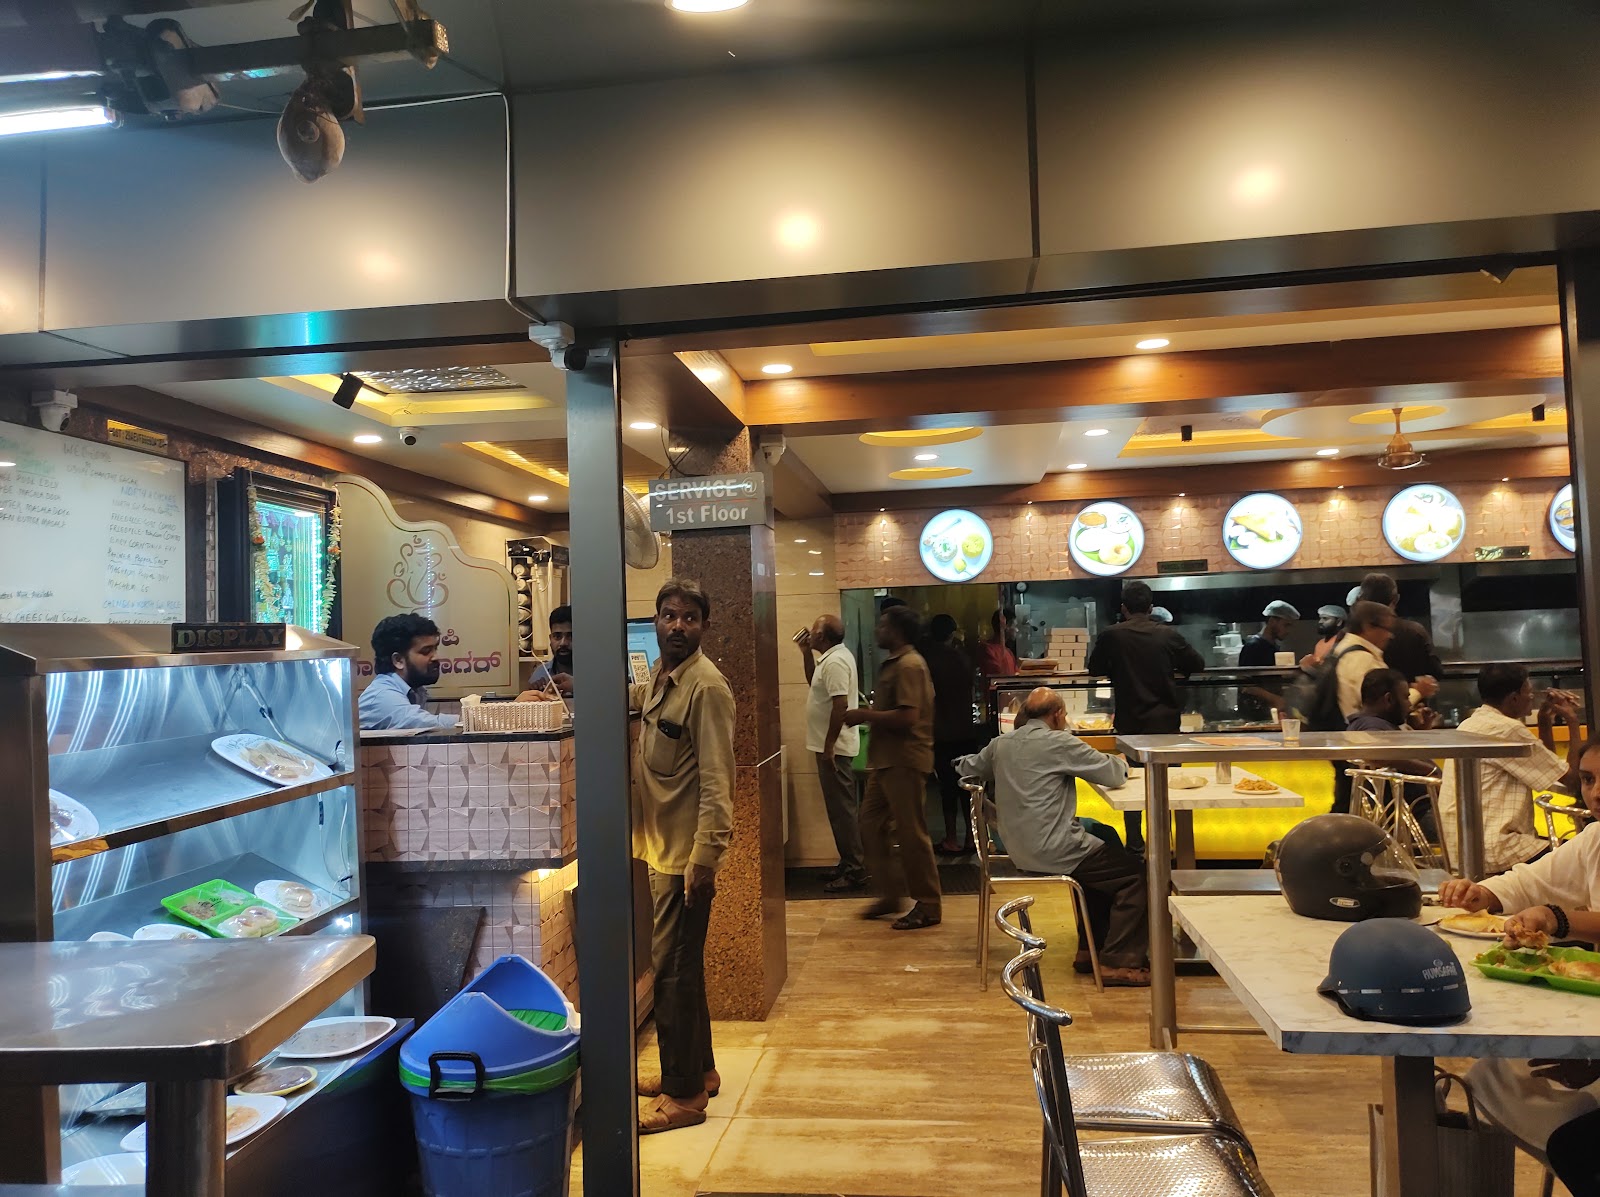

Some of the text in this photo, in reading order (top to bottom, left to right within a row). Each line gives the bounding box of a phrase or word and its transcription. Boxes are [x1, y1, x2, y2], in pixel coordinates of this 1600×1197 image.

[654, 479, 738, 502] SERVICE
[665, 504, 749, 525] 1st Floor
[175, 628, 284, 648] DISPLAY
